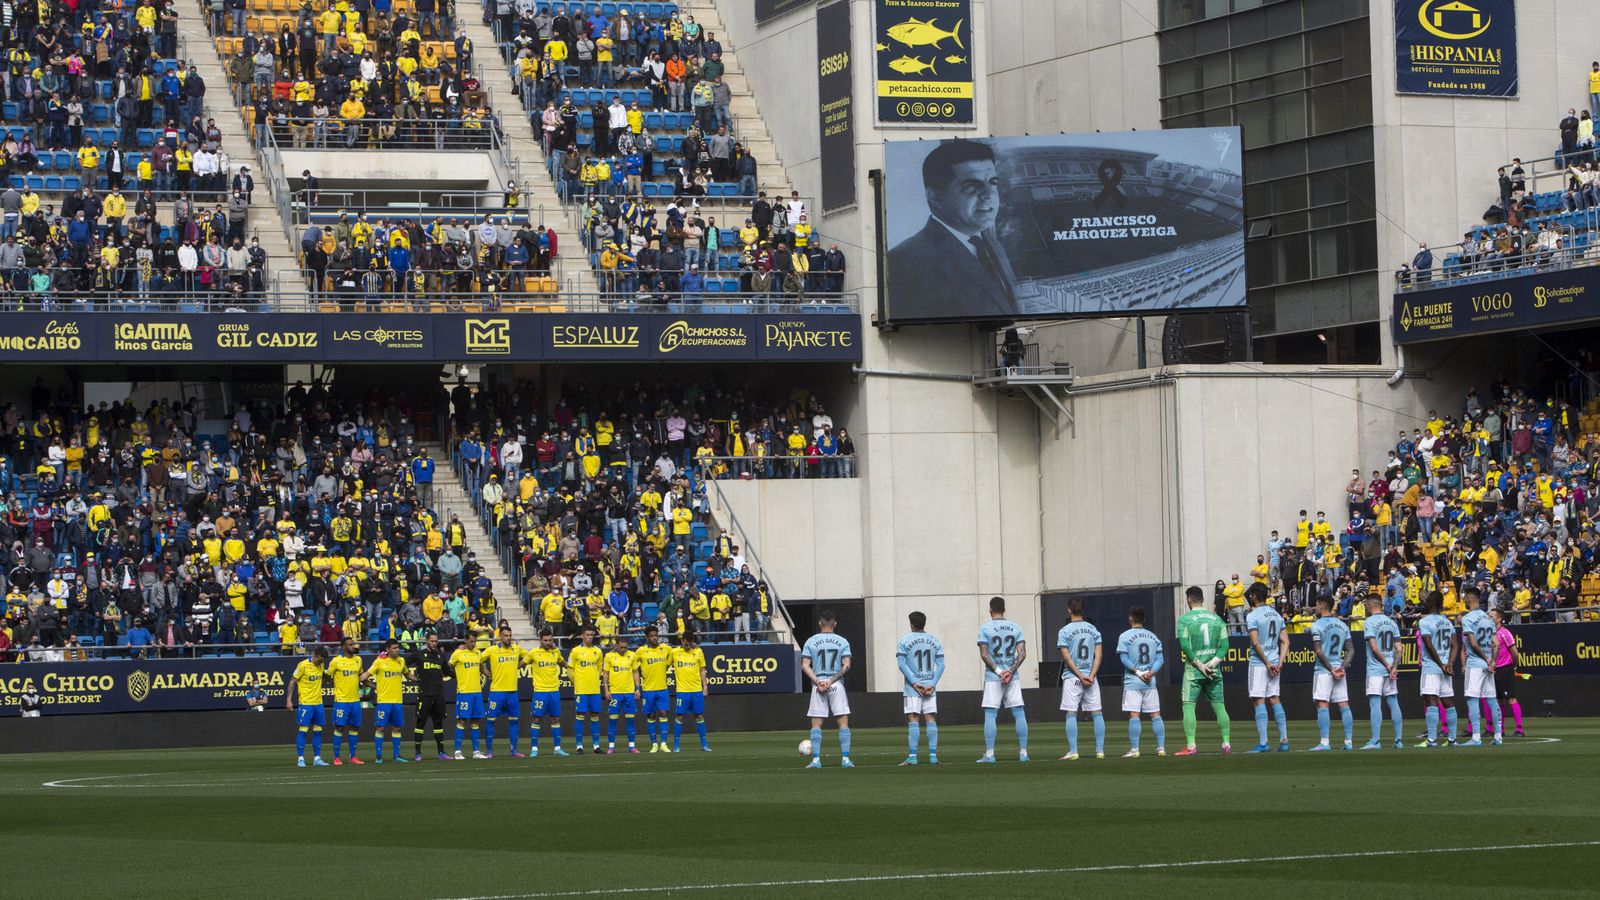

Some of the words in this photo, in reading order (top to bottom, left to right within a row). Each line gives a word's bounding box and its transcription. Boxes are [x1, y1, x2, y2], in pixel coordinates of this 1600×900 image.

[1416, 45, 1496, 62] HISPANIA
[820, 53, 842, 76] asisa
[888, 84, 962, 96] petacachico.com
[836, 109, 848, 120] salud
[1072, 215, 1156, 228] FRANCISCO
[1054, 228, 1128, 240] MÁRQUEZ
[1130, 226, 1178, 237] VEIGA
[1546, 286, 1584, 297] SohoBoutique
[1414, 306, 1422, 317] EL
[1424, 302, 1452, 316] PUENTE
[1472, 292, 1512, 312] VOGO
[46, 320, 79, 336] Cafés
[1414, 318, 1440, 326] FARMACIA
[1442, 315, 1452, 324] 24H
[216, 332, 252, 347] GIL
[256, 332, 318, 347] CADIZ
[334, 330, 361, 341] LAS
[364, 328, 423, 342] CORTES
[553, 326, 639, 344] ESPALUZ
[687, 328, 729, 337] CHICHOS
[765, 324, 852, 351] PAJARETE
[115, 340, 147, 350] Hnos
[151, 340, 192, 351] García
[1200, 622, 1210, 646] 1
[1268, 620, 1277, 641] 4
[1477, 627, 1493, 647] 23
[992, 635, 1016, 657] 22
[1330, 634, 1340, 656] 2
[1378, 631, 1394, 652] 10
[1436, 628, 1450, 650] 15
[1078, 638, 1088, 660] 6
[1138, 643, 1150, 665] 8
[712, 655, 778, 672] CHICO
[817, 649, 838, 671] 17
[914, 649, 932, 672] 11
[1518, 651, 1564, 667] Nutrition
[43, 672, 114, 692] CHICO
[152, 671, 284, 690] ALMADRABA
[725, 675, 766, 685] EXPORT
[57, 694, 102, 704] EXPORT
[460, 701, 468, 710] 23
[534, 700, 543, 709] 32
[576, 695, 580, 704] 4
[609, 699, 618, 707] 22
[676, 698, 682, 706] 11
[336, 709, 344, 718] 15
[378, 710, 385, 719] 12
